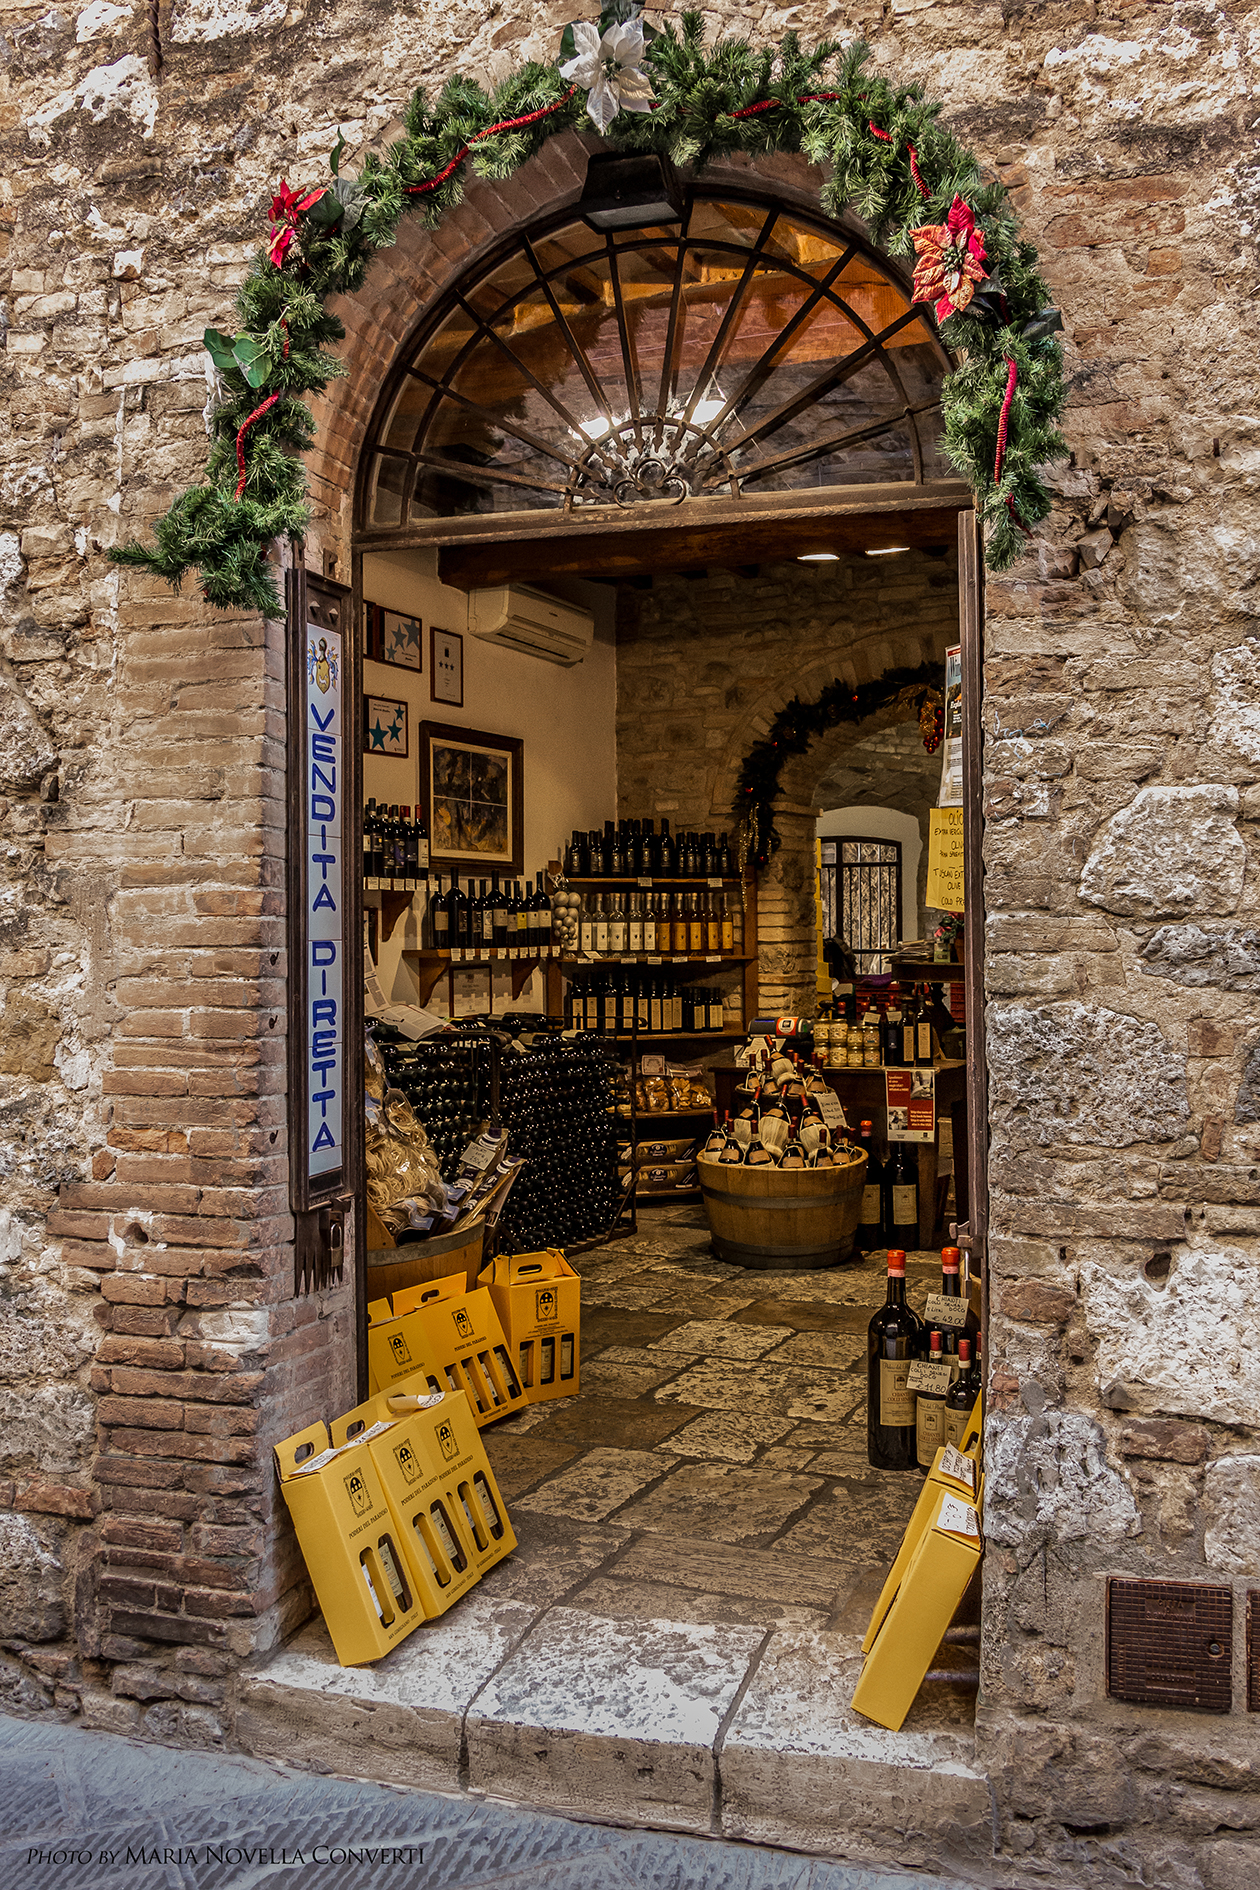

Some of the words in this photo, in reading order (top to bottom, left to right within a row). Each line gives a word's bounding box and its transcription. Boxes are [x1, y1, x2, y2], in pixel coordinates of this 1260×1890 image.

[310, 702, 338, 912] VENDITA
[311, 940, 338, 1152] DIRETTA
[917, 1362, 943, 1371] CHIANTI
